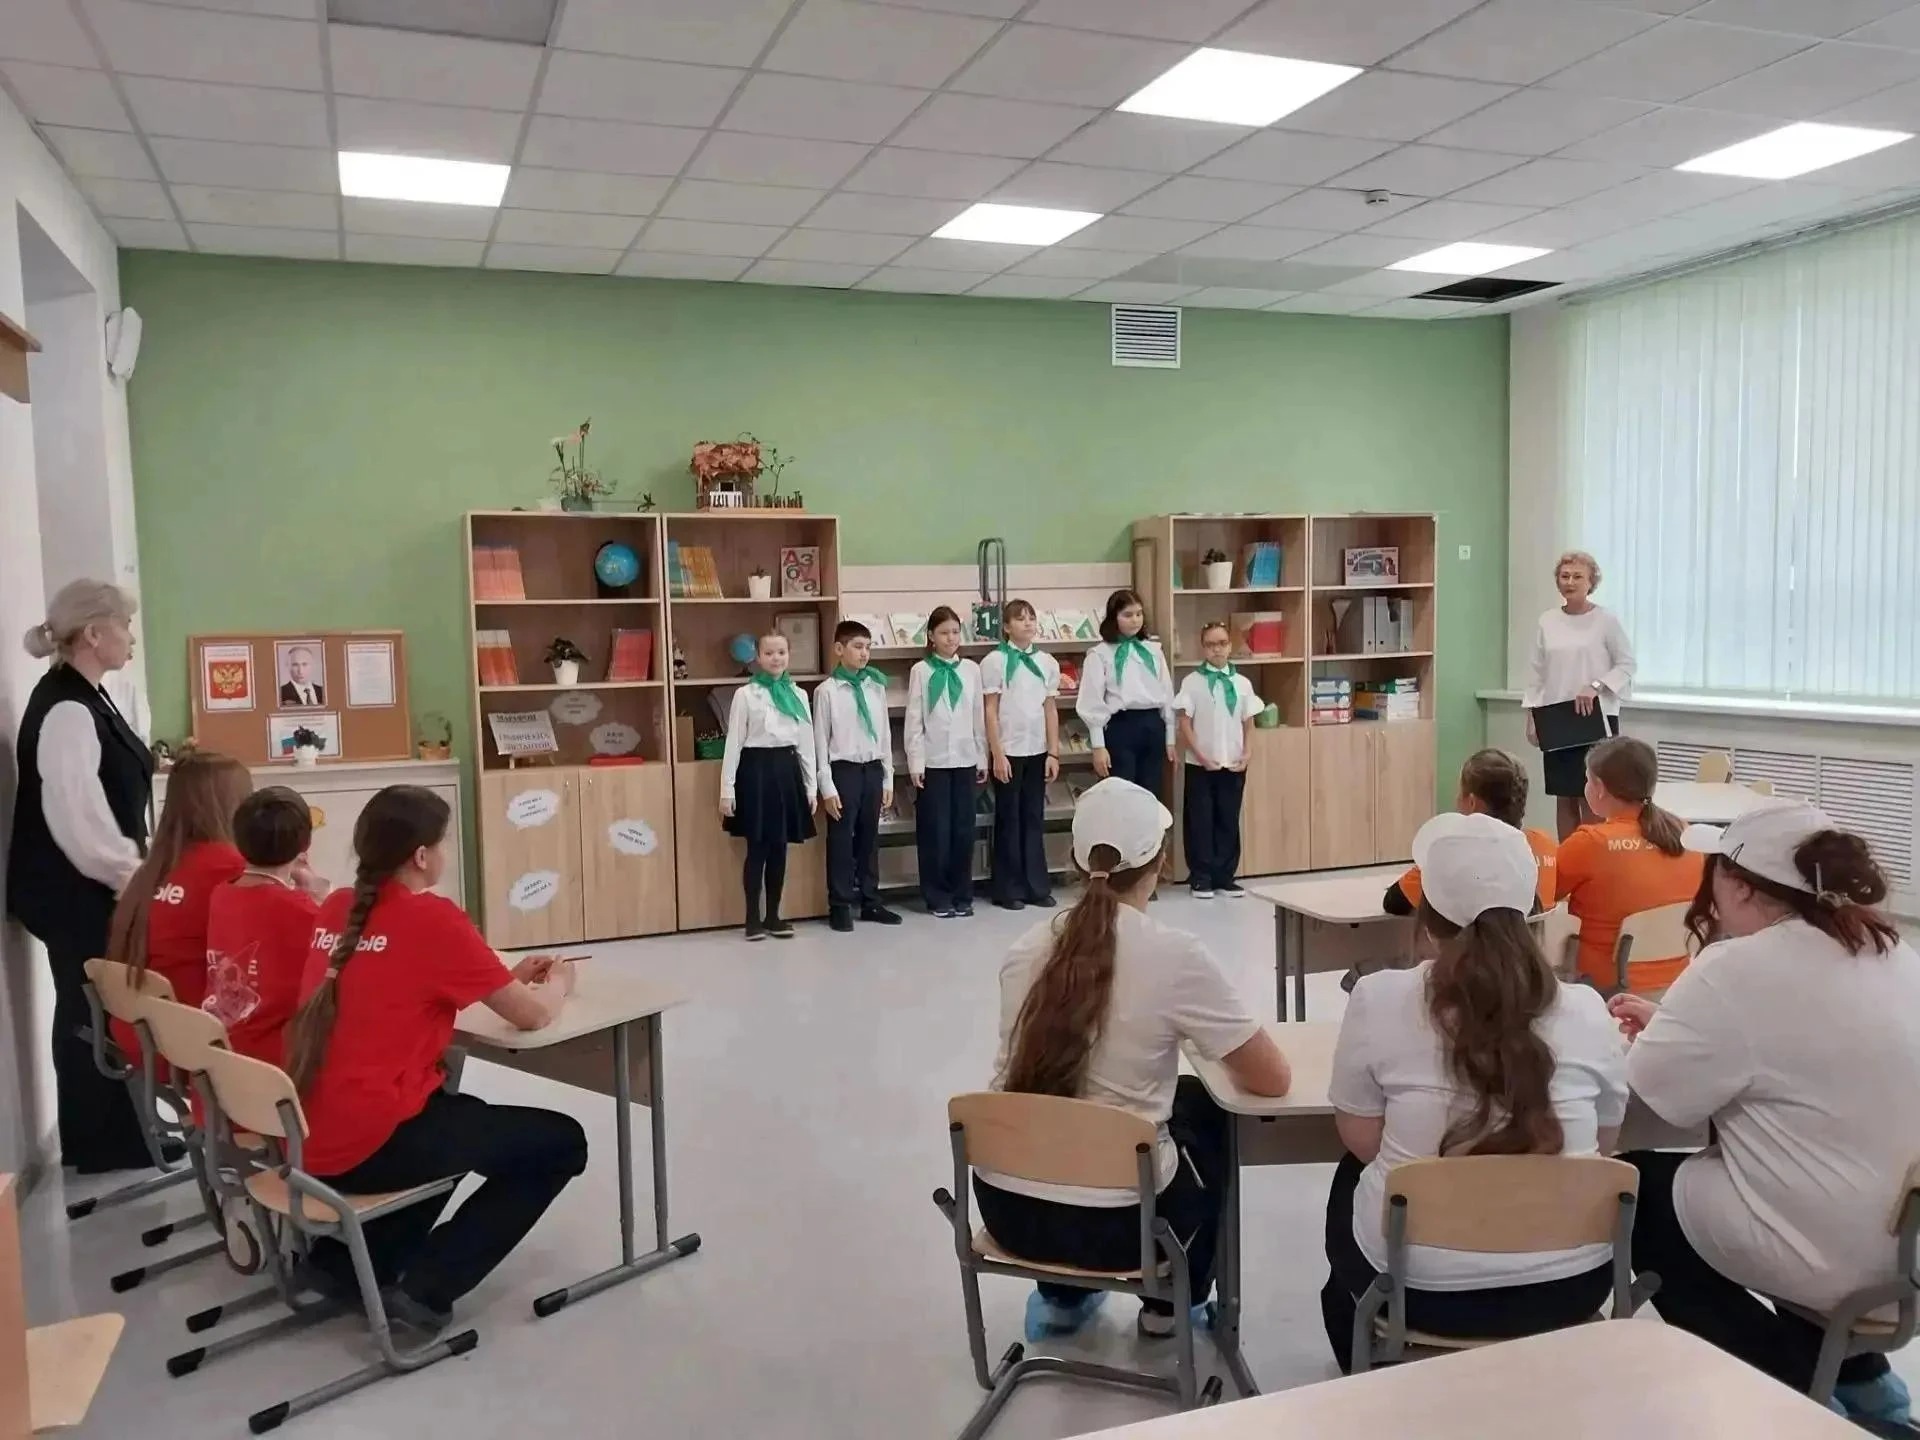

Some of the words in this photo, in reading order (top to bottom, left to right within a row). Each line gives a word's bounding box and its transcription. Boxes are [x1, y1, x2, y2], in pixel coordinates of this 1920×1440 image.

[981, 612, 991, 631] 1
[1608, 839, 1641, 851] МОУ
[311, 927, 388, 957] Перые
